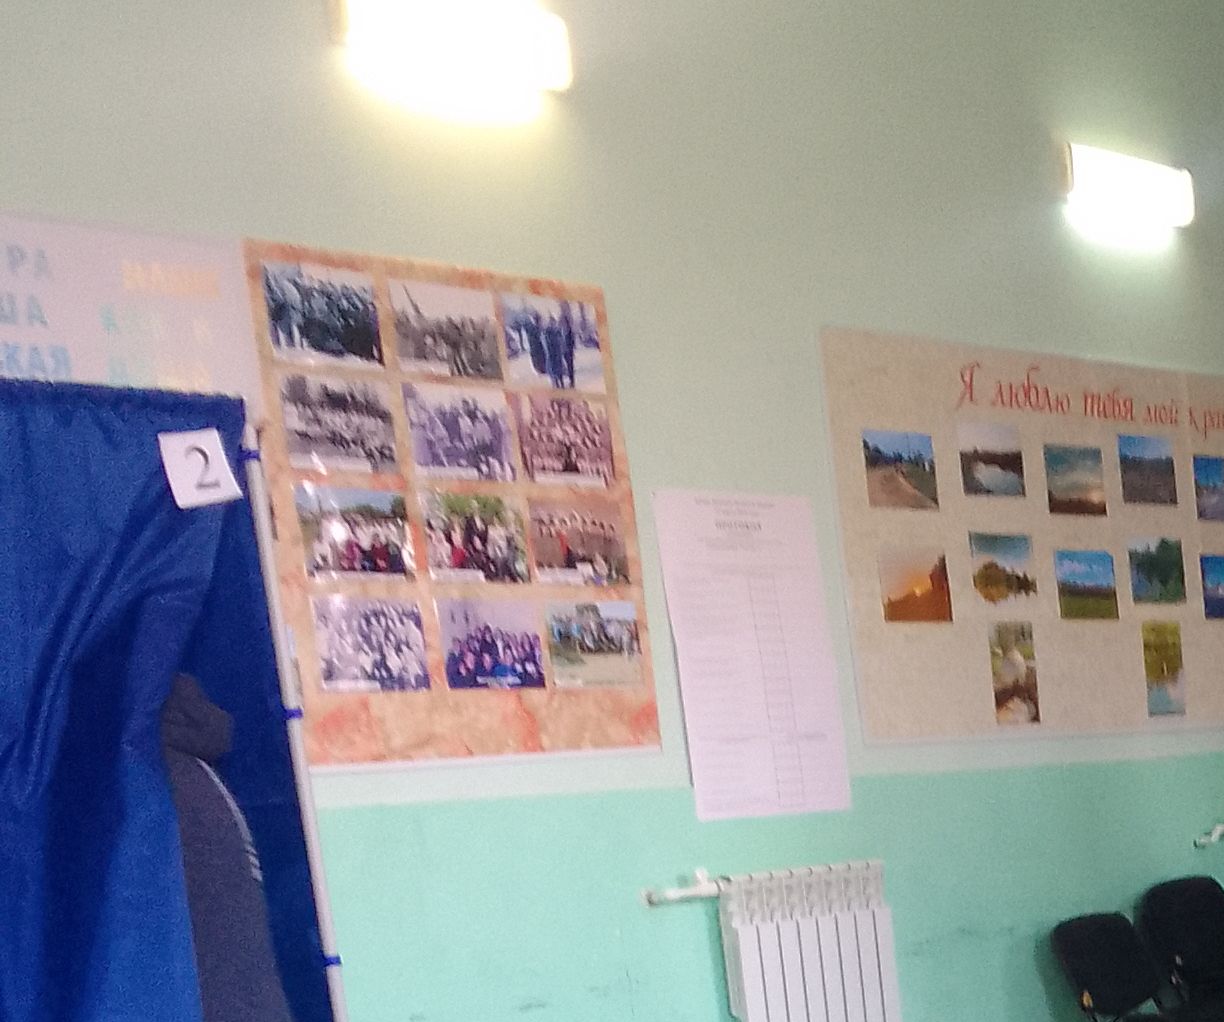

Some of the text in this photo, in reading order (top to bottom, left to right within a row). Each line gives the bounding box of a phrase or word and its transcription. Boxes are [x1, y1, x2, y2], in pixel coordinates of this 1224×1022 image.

[956, 361, 981, 410] Я
[992, 363, 1071, 415] люблю
[1083, 387, 1134, 422] тебя
[184, 445, 221, 490] 2
